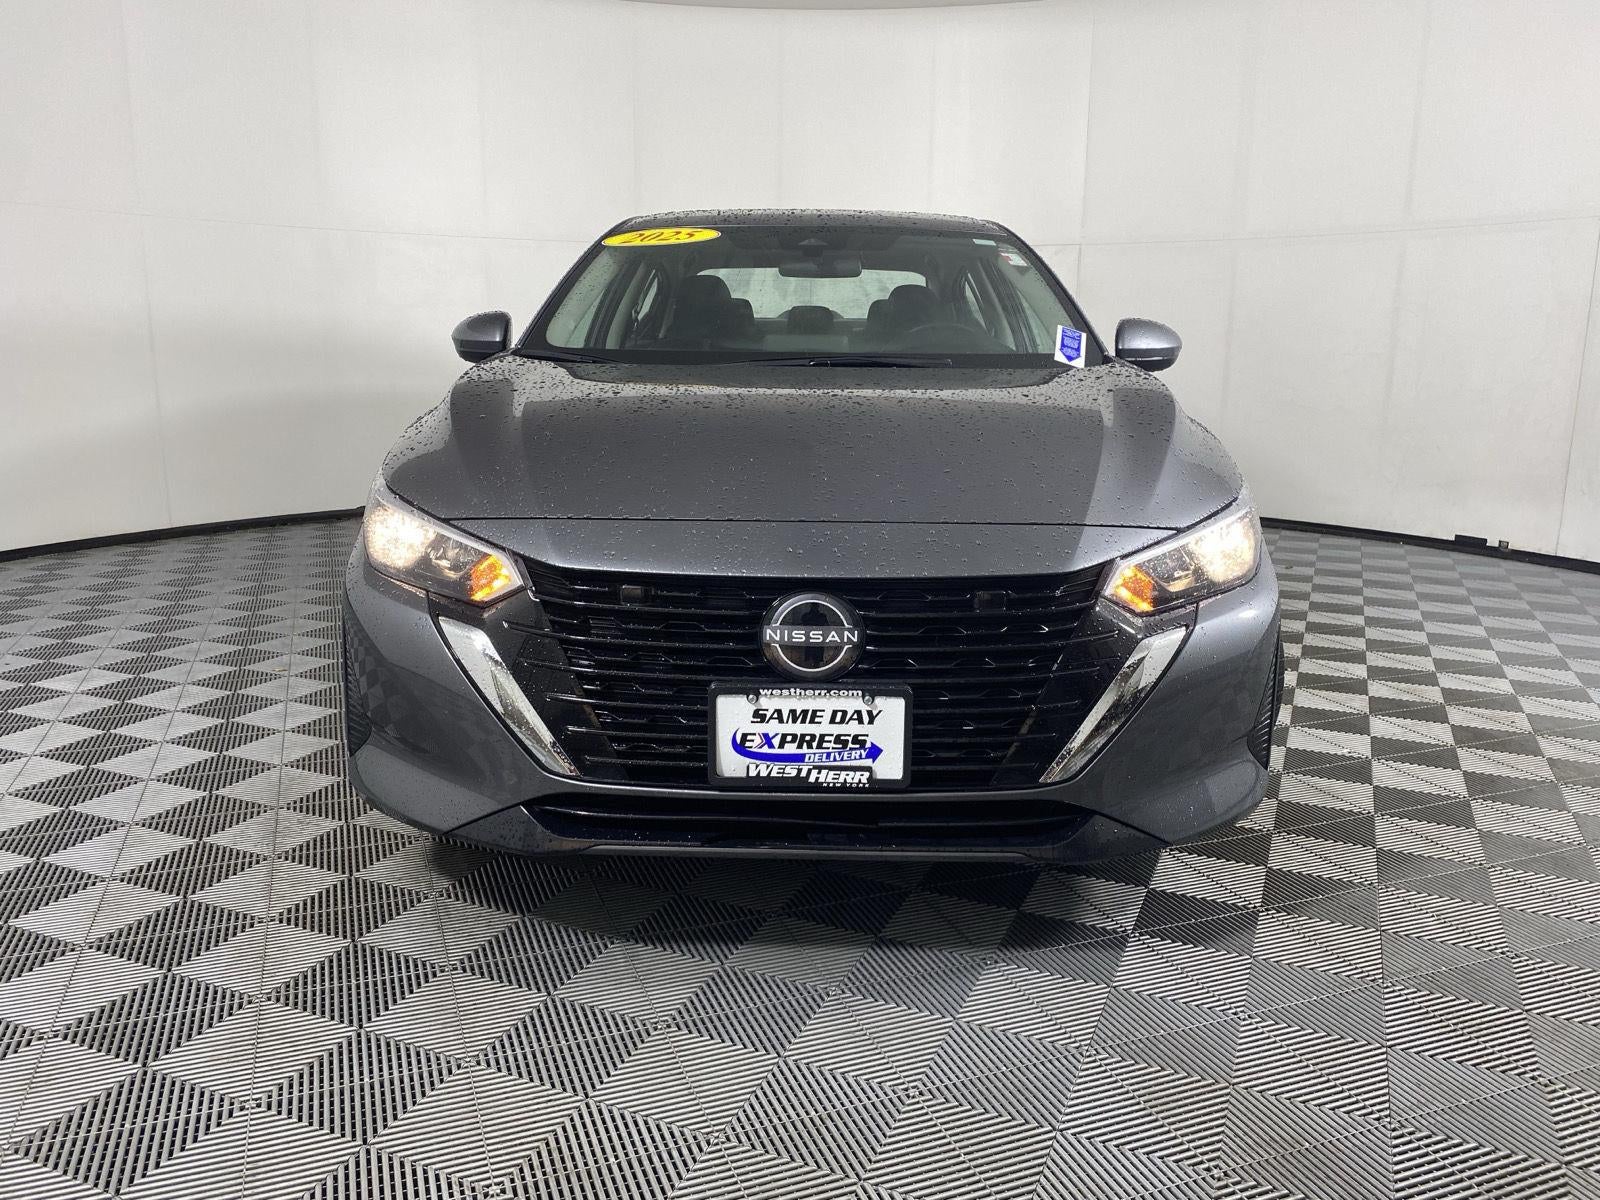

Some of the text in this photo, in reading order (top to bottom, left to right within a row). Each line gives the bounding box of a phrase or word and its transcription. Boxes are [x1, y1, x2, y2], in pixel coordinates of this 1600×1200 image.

[618, 230, 703, 244] 2025
[766, 628, 858, 643] NISSAN
[759, 688, 863, 697] westherr.com
[750, 708, 883, 725] SAME DAY
[739, 732, 869, 750] EXPRESS
[804, 750, 869, 763] DELIVERY
